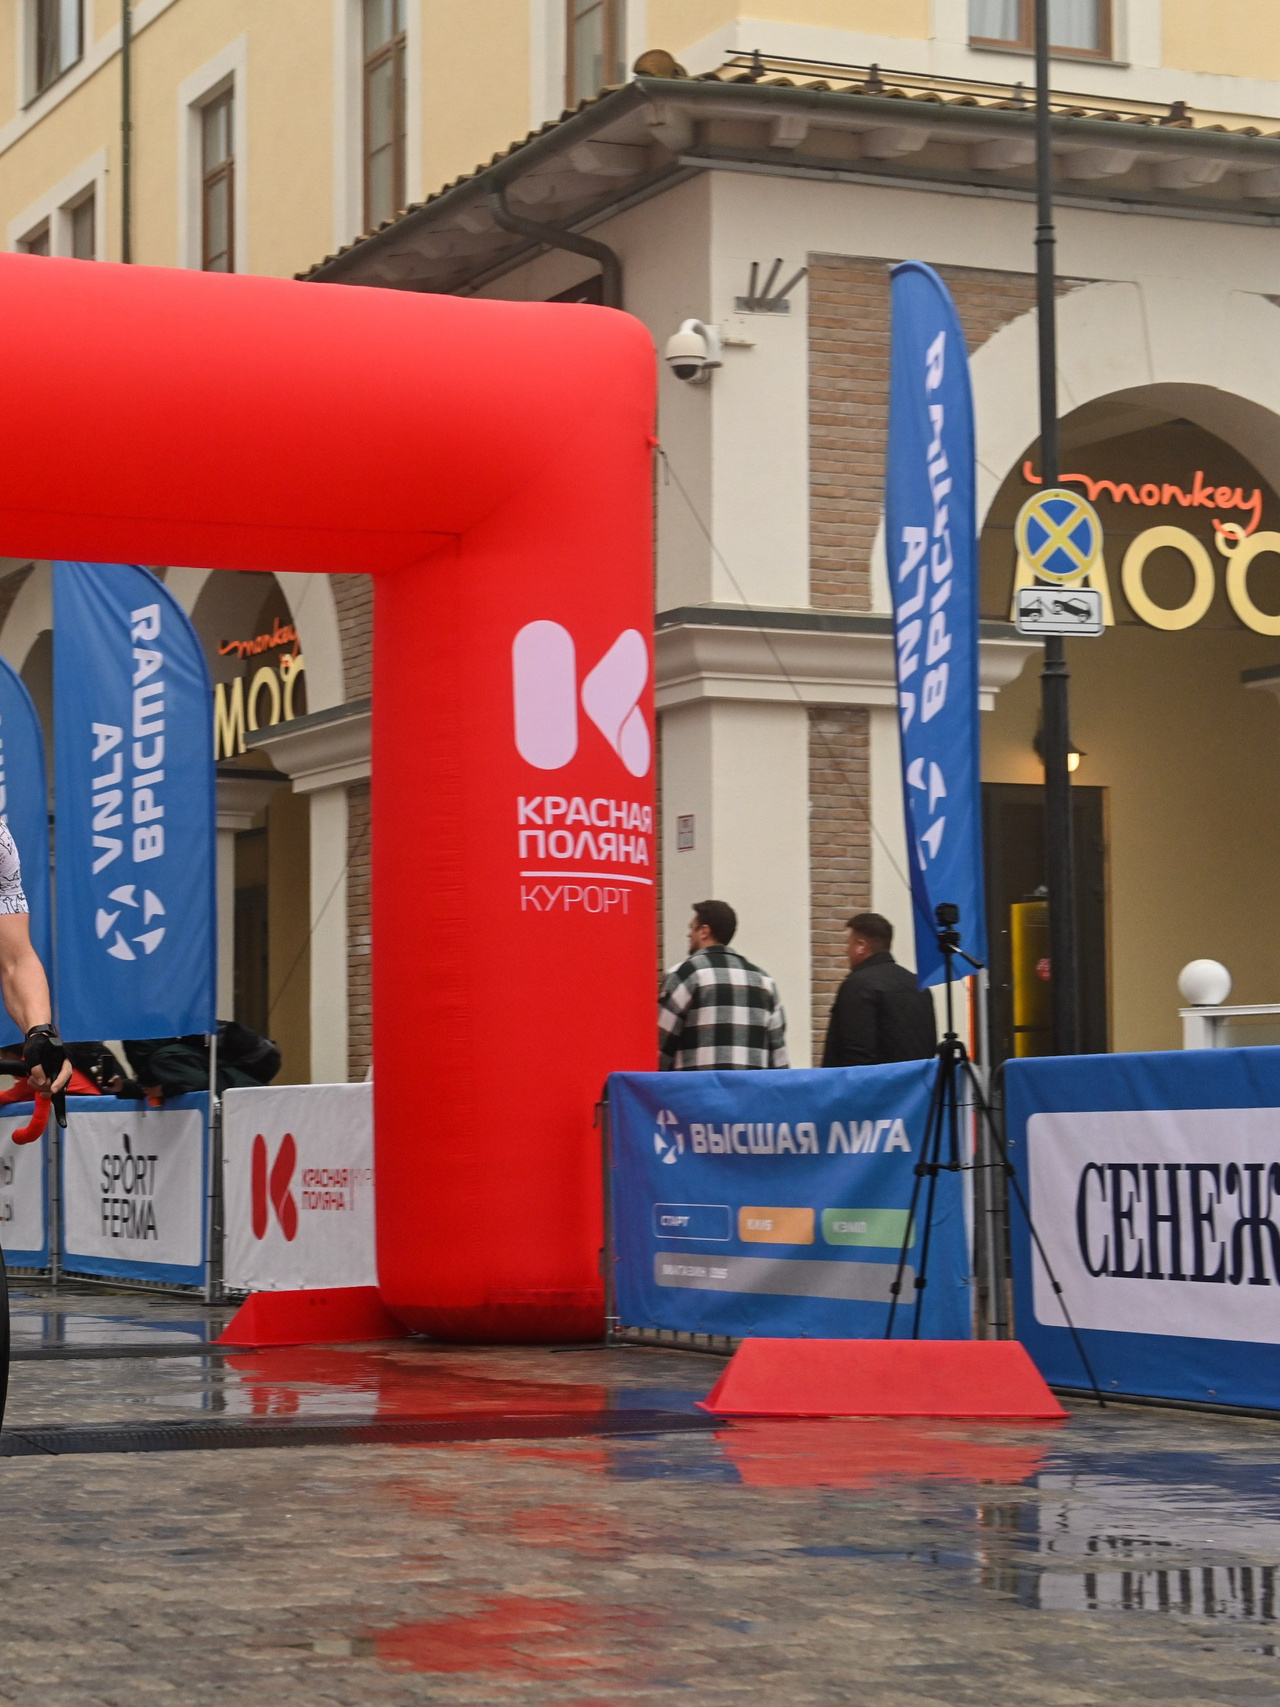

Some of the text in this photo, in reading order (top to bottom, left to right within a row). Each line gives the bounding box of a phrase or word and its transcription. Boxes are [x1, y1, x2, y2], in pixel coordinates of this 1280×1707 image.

[1023, 461, 1263, 540] monkey
[218, 617, 301, 667] monkey
[517, 796, 653, 835] КРАСНАЯ
[518, 829, 650, 866] ПОЛЯНА
[520, 884, 632, 915] КУРОРТ
[689, 1117, 913, 1155] ВЫСШАЯ ЛИГА
[100, 1148, 158, 1195] SPORT
[301, 1168, 349, 1188] КРАСНАЯ
[100, 1198, 159, 1241] FERMA
[1075, 1161, 1280, 1287] СЕНЕЖ
